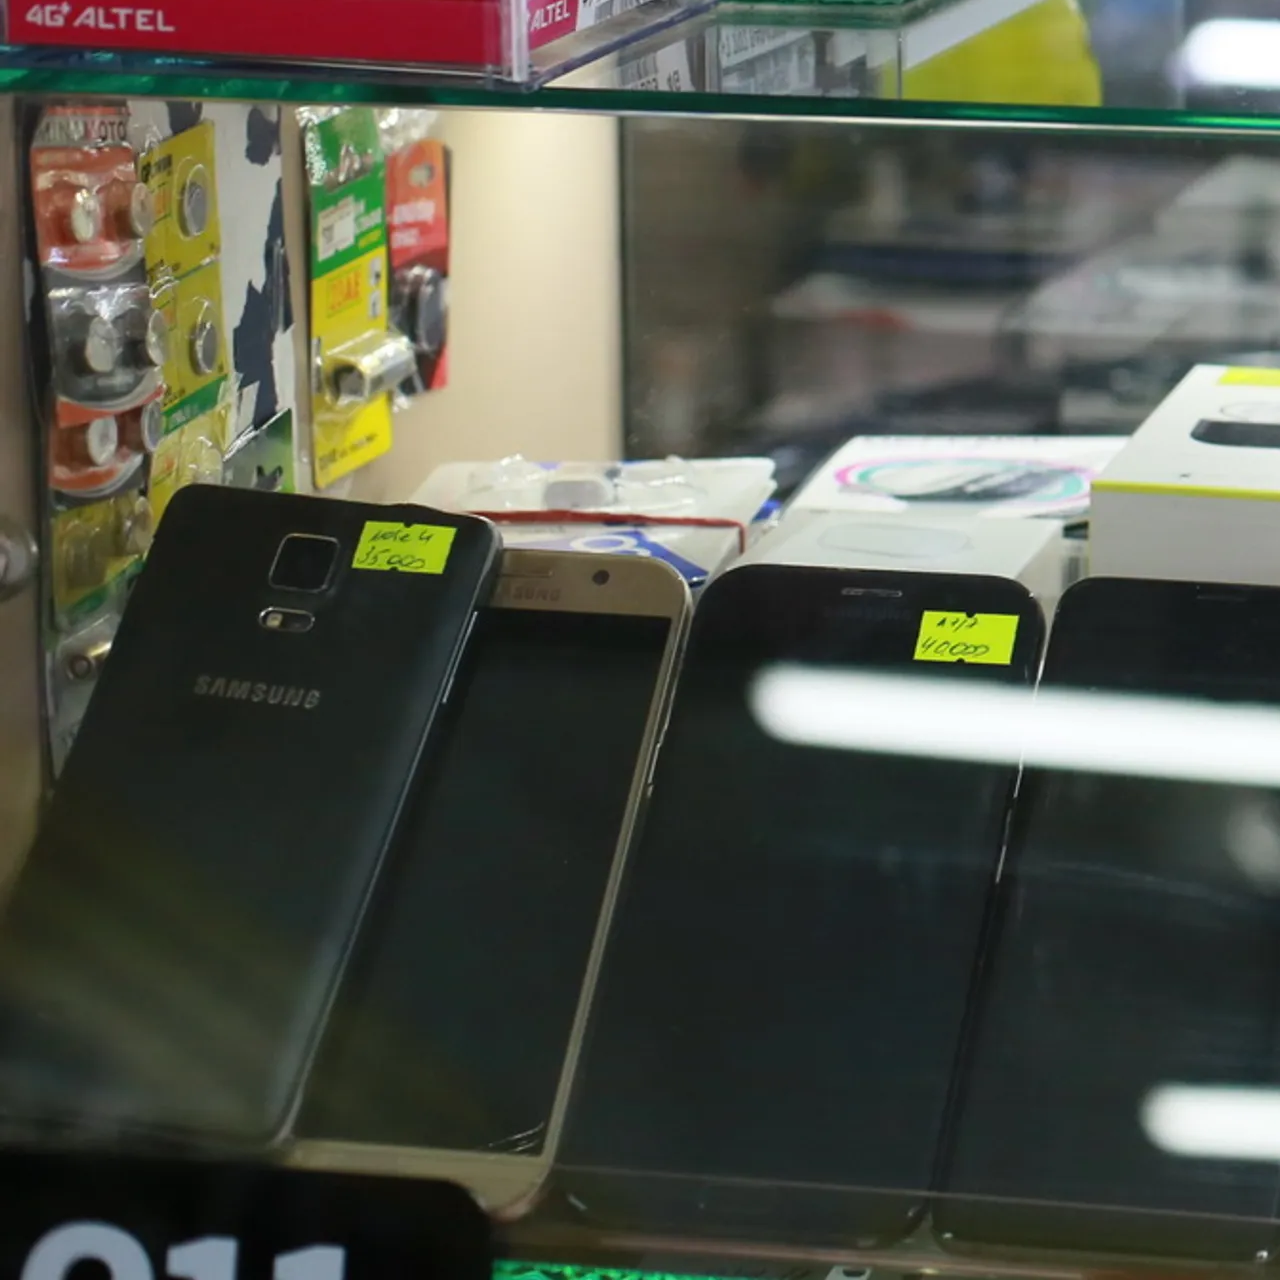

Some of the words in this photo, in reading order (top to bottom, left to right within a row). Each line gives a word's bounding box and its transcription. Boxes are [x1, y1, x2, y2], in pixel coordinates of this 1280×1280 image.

[75, 8, 173, 31] ALTEL
[530, 0, 570, 32] ALTEL
[194, 674, 321, 709] SAMSUNG
